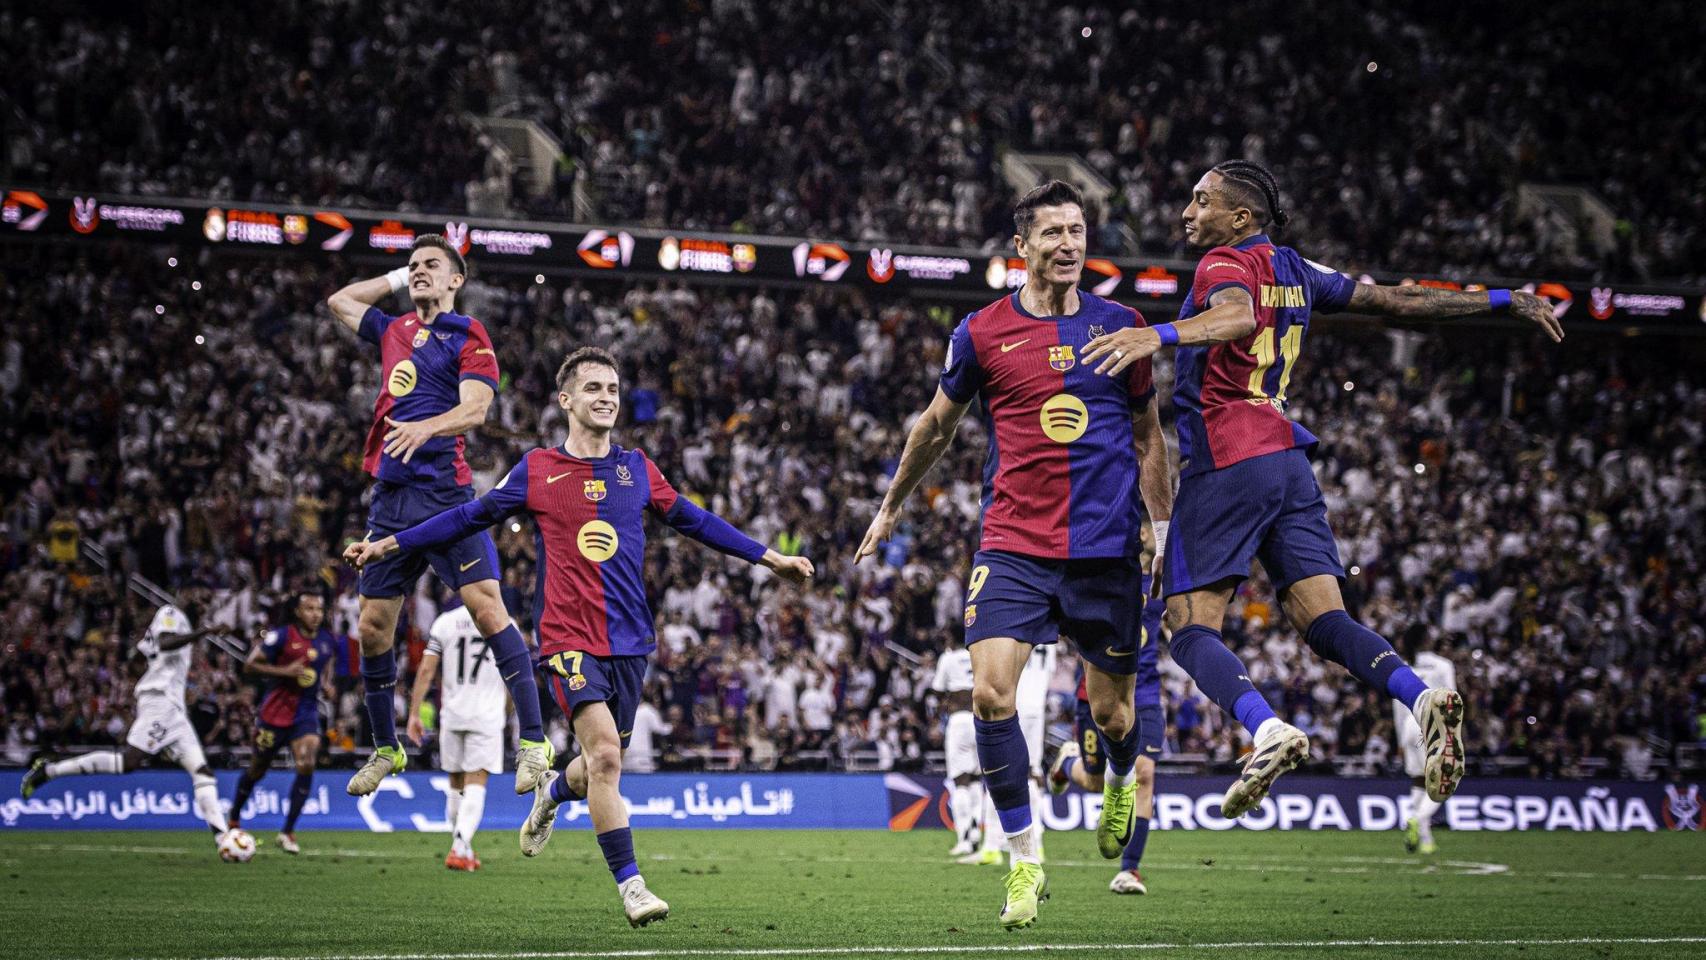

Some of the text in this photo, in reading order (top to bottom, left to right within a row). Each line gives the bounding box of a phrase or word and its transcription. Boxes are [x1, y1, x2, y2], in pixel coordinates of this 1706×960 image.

[1248, 325, 1304, 400] 11
[968, 565, 990, 602] 9
[455, 636, 490, 685] 17
[549, 651, 583, 680] 17
[1084, 729, 1097, 754] 8
[1042, 793, 1352, 831] UPRCOPA
[1446, 786, 1658, 832] ESPAÑA
